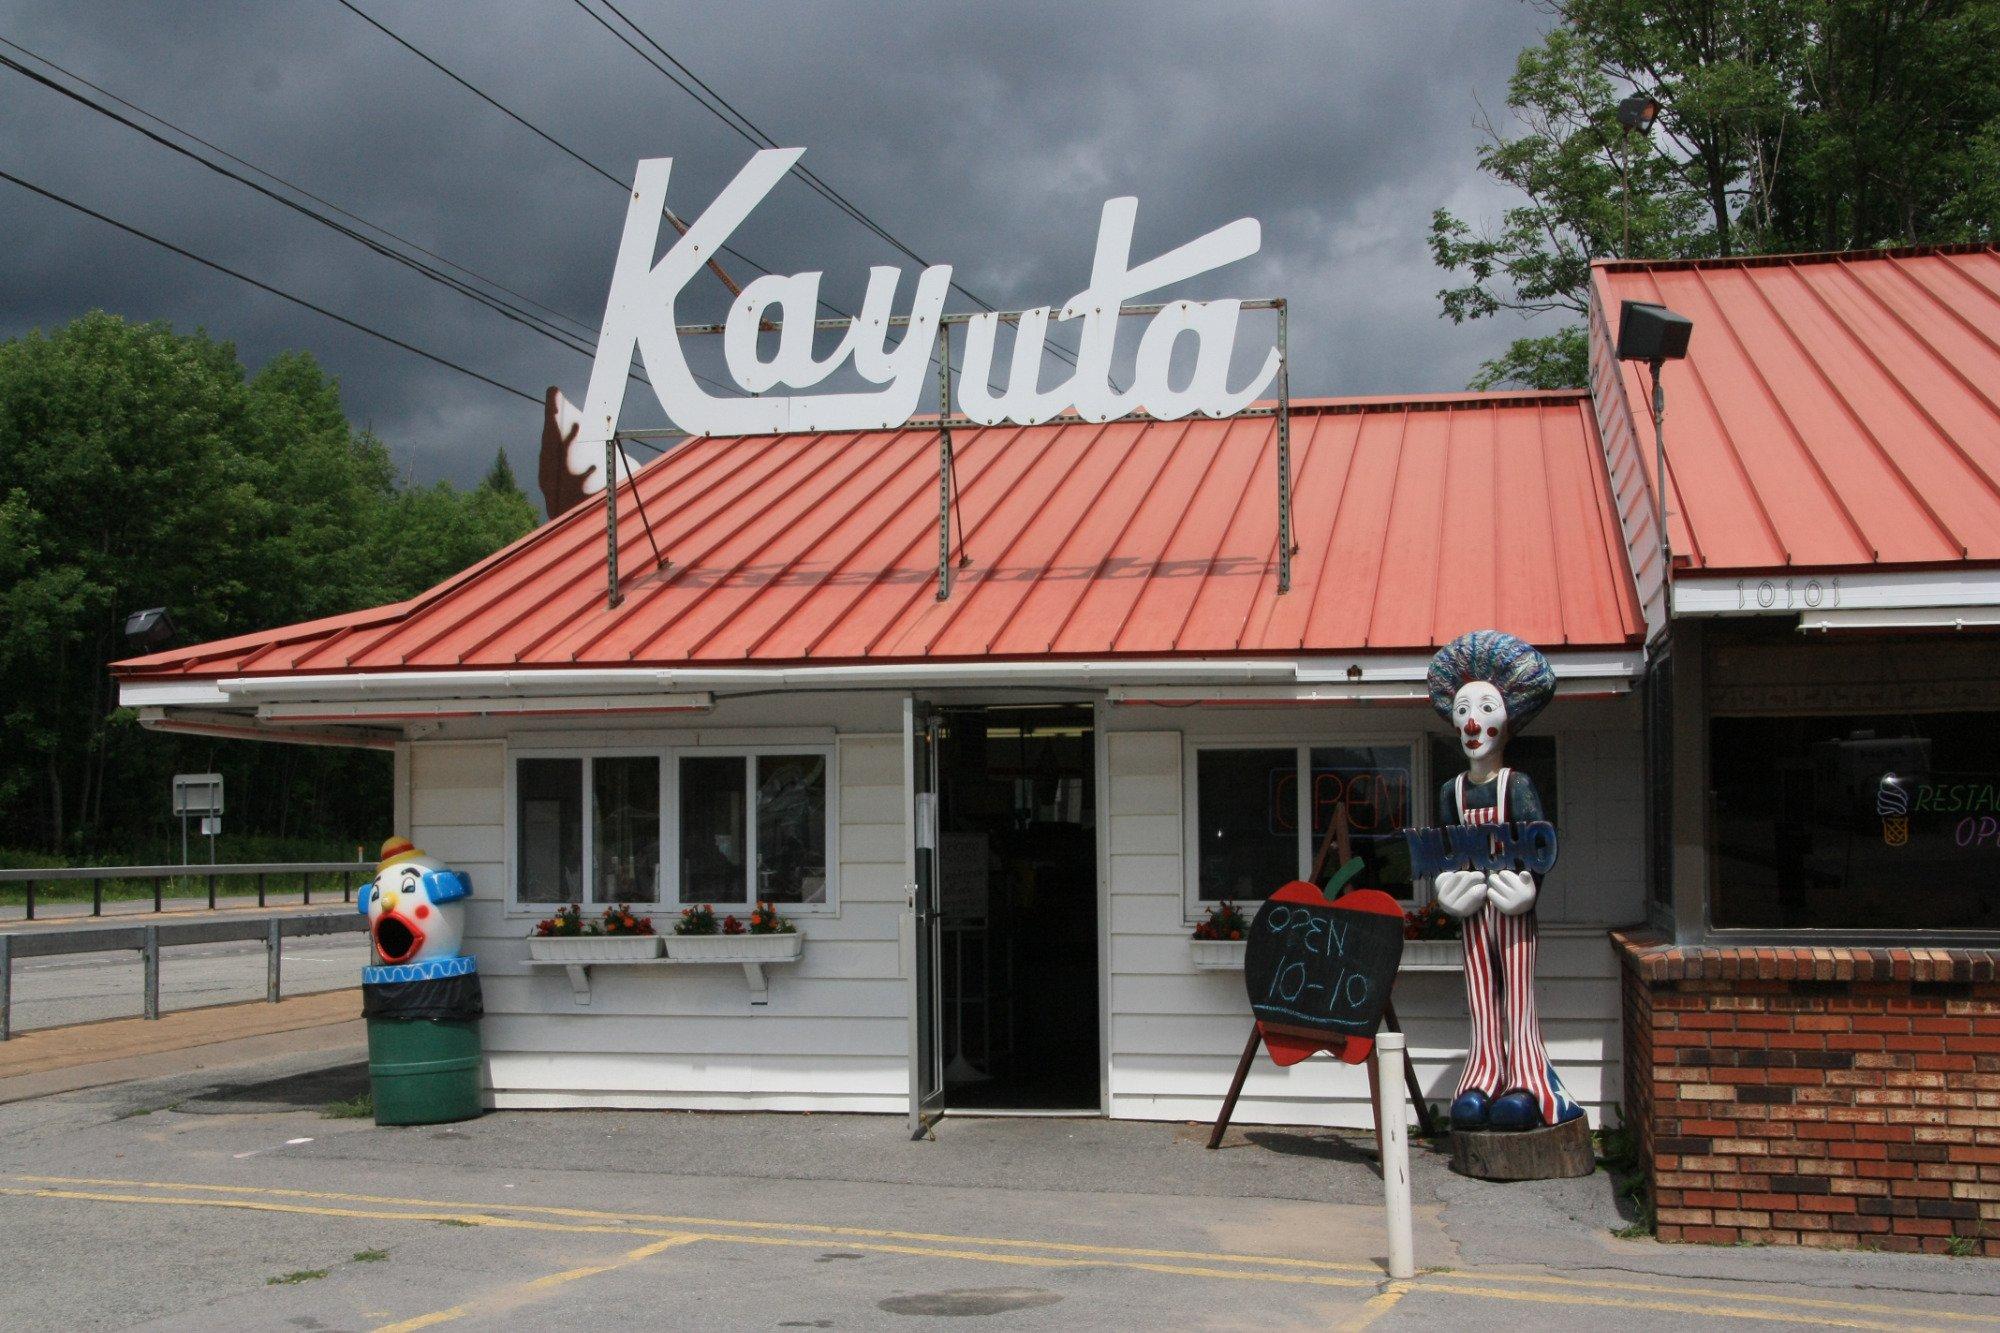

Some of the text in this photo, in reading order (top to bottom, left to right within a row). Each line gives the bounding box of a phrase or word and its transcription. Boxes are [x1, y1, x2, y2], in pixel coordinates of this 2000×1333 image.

[579, 146, 1284, 440] Kayuta
[1736, 577, 1841, 609] 10101
[1914, 784, 2000, 812] RESTA
[1955, 816, 2000, 848] OP
[1267, 906, 1349, 957] OPEN
[1268, 955, 1369, 1011] 10-10
